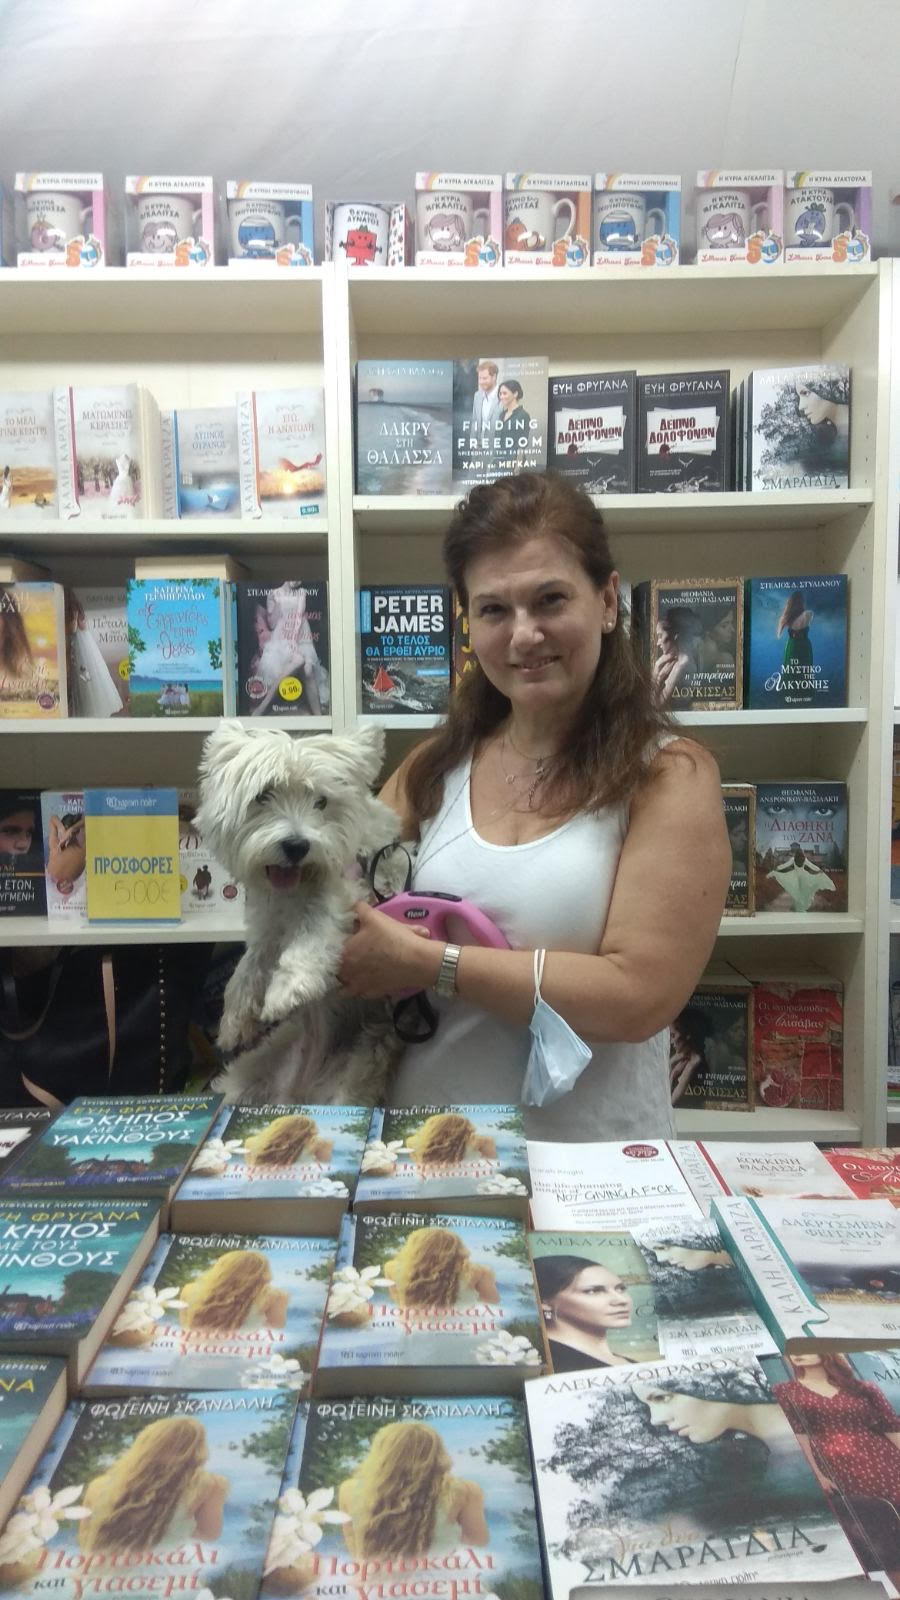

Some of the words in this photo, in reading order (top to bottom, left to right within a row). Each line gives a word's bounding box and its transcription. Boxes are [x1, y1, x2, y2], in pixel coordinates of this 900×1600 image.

[552, 384, 573, 395] ΕΥΗ
[576, 379, 628, 392] ΦΡΥΓΑΝΑ
[644, 383, 665, 394] ΕΥΗ
[670, 380, 722, 392] ΦΡΥΓΑΝΑ
[379, 422, 431, 436] ΔΑΚΡΥ
[462, 419, 538, 432] FINDING
[568, 416, 604, 431] ΔΕΙΠΝΟ
[660, 416, 696, 431] ΔΕΙΠΝΟ
[458, 436, 542, 449] FREEDOM
[558, 427, 622, 444] ΔΟΛΟΦΟΝΩΝ
[649, 427, 715, 444] ΔΟΛΟΦΟΝΩΝ
[395, 438, 414, 448] ΣΤΗ
[367, 450, 443, 465] ΘΑΛΑΣΣΑ
[462, 460, 484, 470] ΧΑΡΙ
[498, 460, 537, 468] ΜΕΓΚΑΝ
[760, 582, 791, 590] ΣΤΕΛΙΟΣ
[800, 580, 841, 588] ΣΤΥΛΙΑΝΟΥ
[374, 595, 444, 614] PETER
[373, 614, 444, 633] JAMES
[380, 636, 394, 646] ΤΟ
[397, 634, 430, 646] ΤΕΛΟΣ
[366, 646, 380, 656] ΘΑ
[383, 646, 412, 656] ΕΡΘΕΙ
[414, 645, 446, 656] ΑΥΡΙΟ
[780, 664, 822, 674] ΜΥΣΤΙΚΟ
[790, 658, 799, 666] ΤΟ
[672, 686, 736, 698] ΔΟΥΚΙΣΣΑΣ
[798, 832, 834, 843] ΖΑΝΑ
[94, 856, 174, 875] ΠΡΟΣΦΟΡΕΣ
[407, 910, 428, 918] flexi
[684, 1086, 746, 1098] ΔΟΥΚΙΣΣΑΣ
[120, 1103, 208, 1114] ΦΡΥΓΑΝΑ
[76, 1116, 94, 1126] Ο
[98, 1111, 190, 1126] ΚΗΠΟΣ
[52, 1130, 194, 1146] ΥΑΚΙΝΘΟΥΣ
[736, 1156, 800, 1166] ΚΟΚΚΙΝΗ
[556, 1193, 580, 1203] NOT
[584, 1188, 629, 1202] GIVING
[630, 1188, 641, 1197] A
[31, 1210, 140, 1222] ΦΡΥΓΑΝΑ
[362, 1216, 425, 1227] ΦΩΤΕΙΝΗ
[2, 1222, 117, 1239] ΚΗΠΟΣ
[782, 1217, 896, 1230] ΔΑΚΡΥΣΜΕΝΑ
[728, 1202, 774, 1262] ΚΑΡΑΤΖΑ
[31, 1240, 82, 1250] ΤΟΥΣ
[178, 1236, 240, 1249] ΦΩΤΕΙΝΗ
[536, 1238, 592, 1246] ΑΛΕΚΑ
[766, 1270, 804, 1314] ΚΑΛΗ
[544, 1376, 616, 1395] ΑΛΕΚΑ
[622, 1358, 740, 1385] ΖΩΓΡΑΦΟΥ
[90, 1402, 170, 1420] ΦΩΤΕΙΝΗ
[174, 1398, 273, 1413] ΣΚΑΝΔΑΛΗ
[317, 1403, 396, 1420] ΦΩΤΕΙΝΗ
[402, 1403, 500, 1416] ΣΚΑΝΔΑΛΗ
[34, 1544, 218, 1574] Πορτοκάλι
[581, 1525, 820, 1583] ΣΜΑΡΑΓΔΙΑ
[311, 1550, 496, 1581] Πορτοκάλι
[33, 1578, 66, 1590] και
[72, 1570, 200, 1596] γιασεμί
[316, 1584, 347, 1596] και
[358, 1576, 483, 1600] γιασεμί
